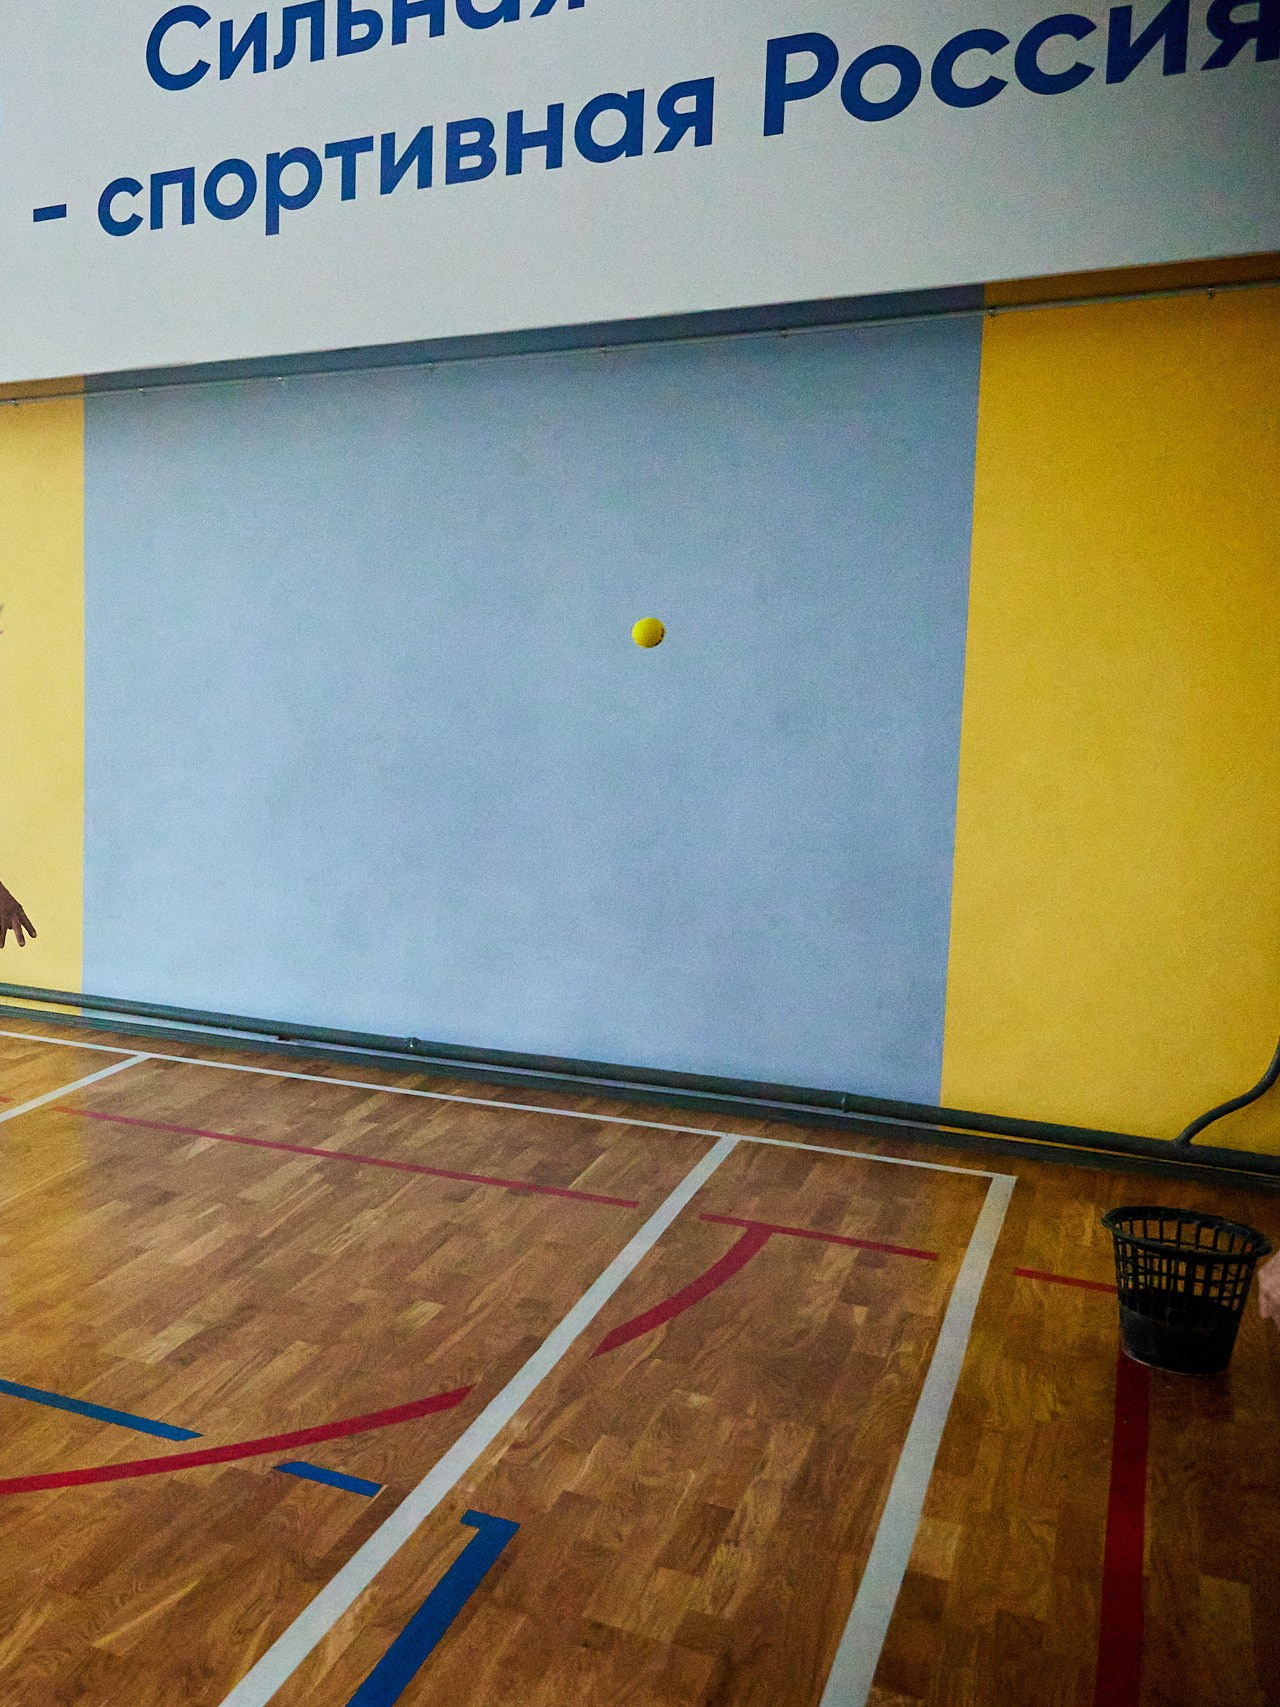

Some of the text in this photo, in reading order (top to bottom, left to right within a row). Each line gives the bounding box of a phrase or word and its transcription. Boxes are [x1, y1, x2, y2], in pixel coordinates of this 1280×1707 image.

[98, 77, 714, 236] спортивная
[763, 0, 1280, 136] Россия
[146, 0, 585, 91] Сильн
